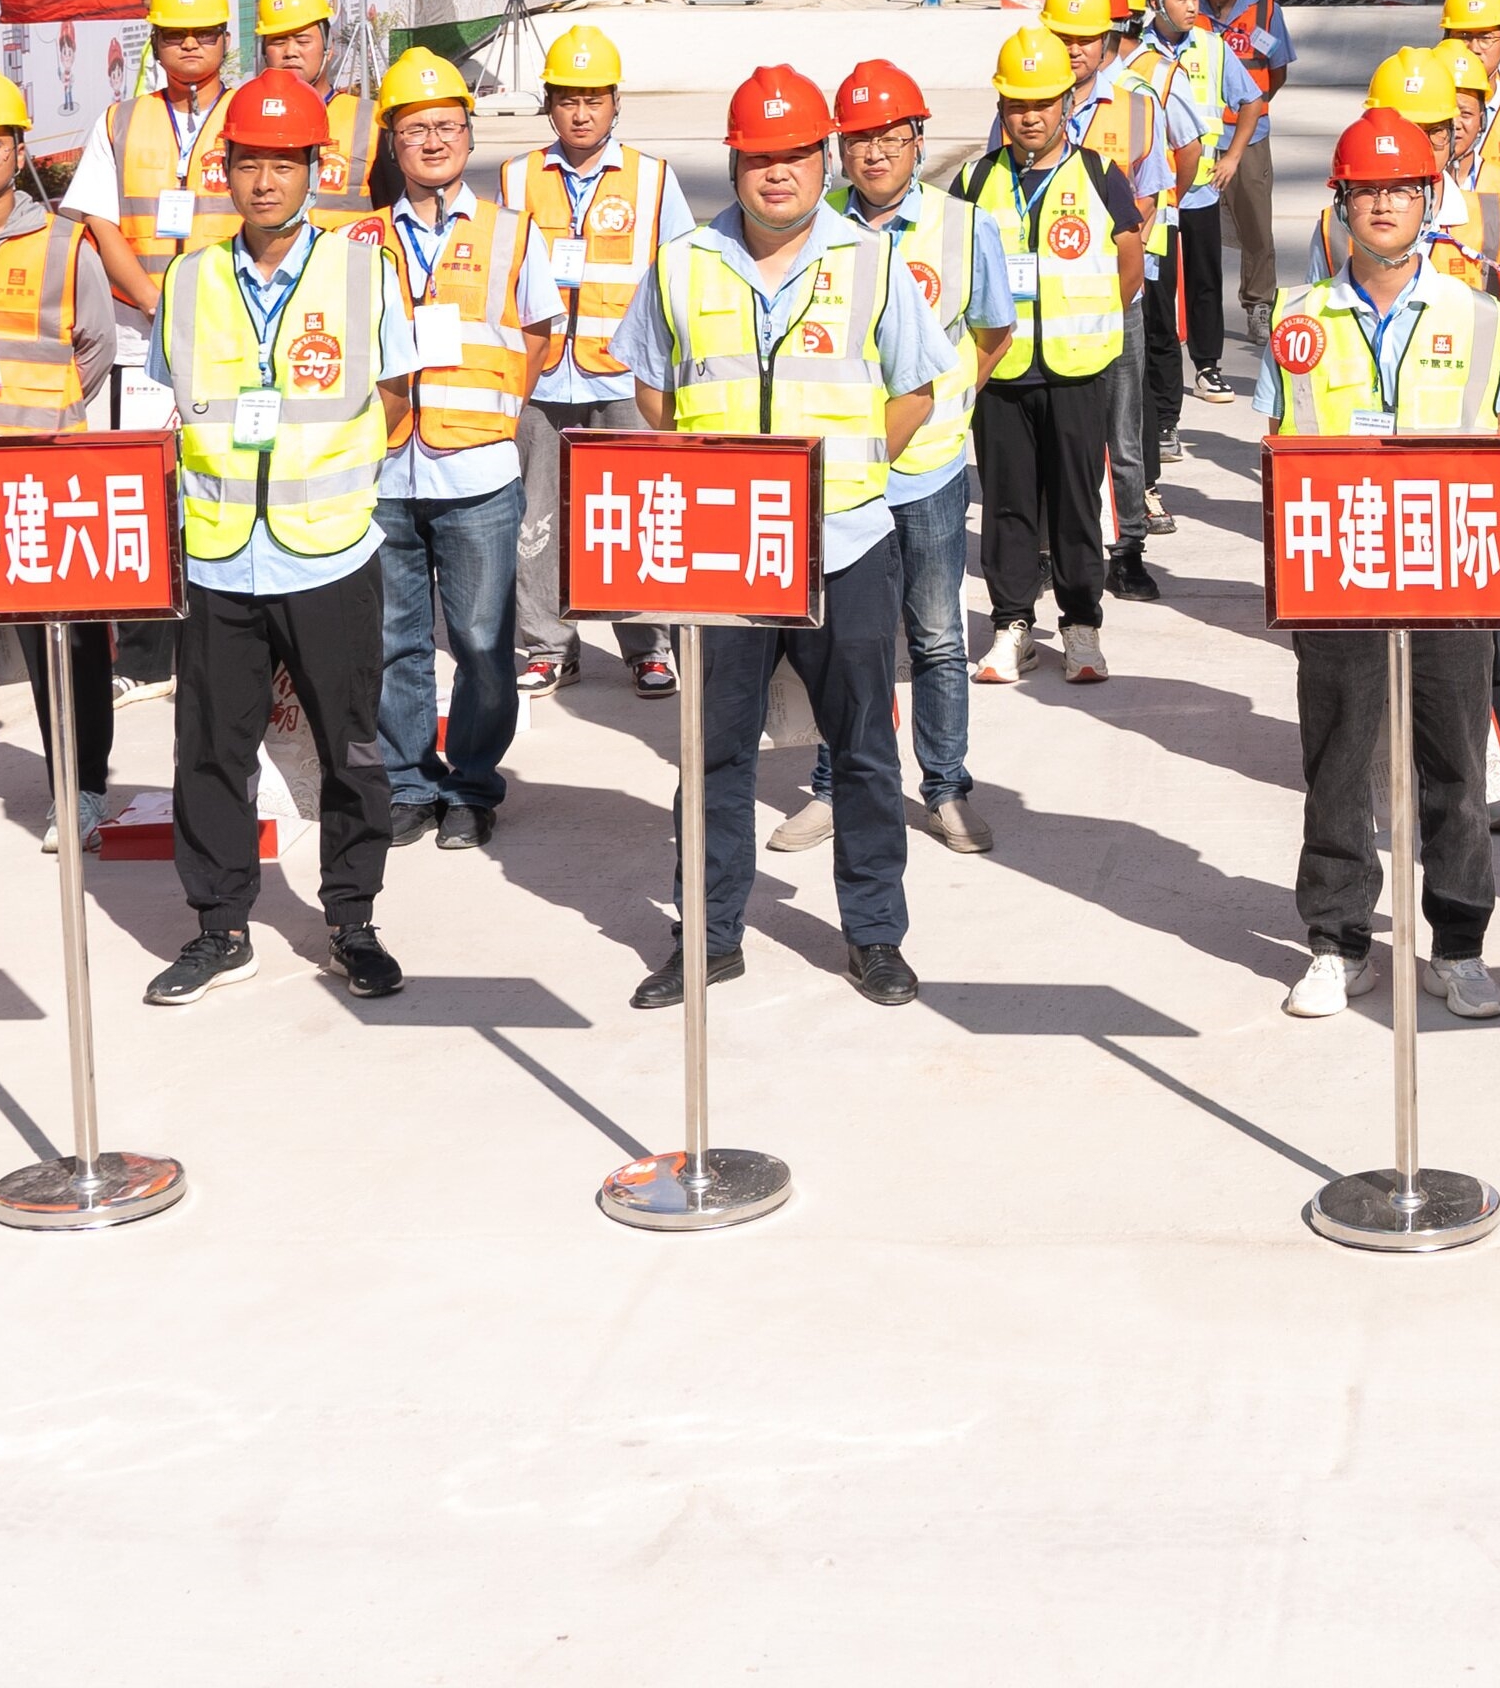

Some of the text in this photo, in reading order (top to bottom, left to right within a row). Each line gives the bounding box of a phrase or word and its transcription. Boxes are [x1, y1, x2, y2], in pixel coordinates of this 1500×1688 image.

[1057, 227, 1080, 250] 54
[1285, 329, 1312, 363] 10
[583, 470, 796, 591] 中建二局
